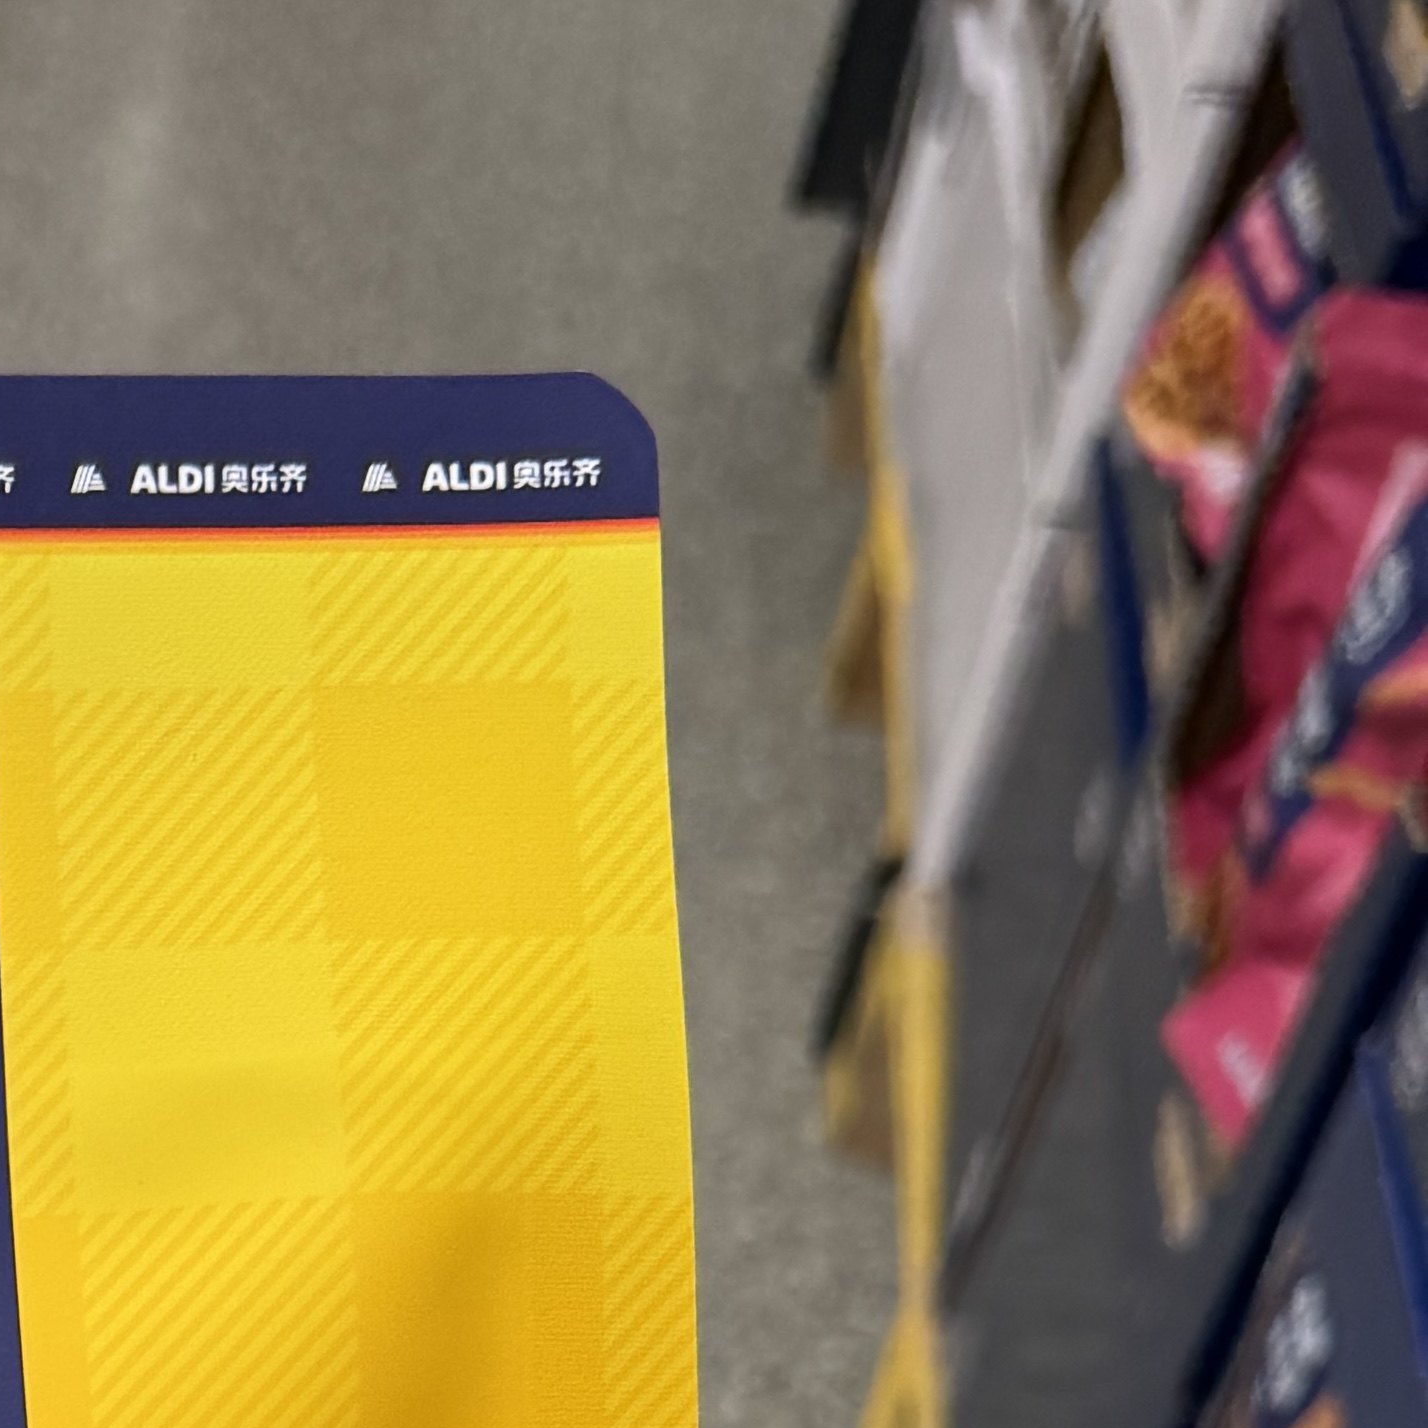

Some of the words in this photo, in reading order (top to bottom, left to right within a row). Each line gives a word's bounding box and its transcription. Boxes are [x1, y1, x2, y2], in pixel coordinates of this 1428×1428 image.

[130, 463, 215, 494] ALDI
[221, 463, 307, 494] 奥乐齐
[422, 461, 507, 492] ALDI
[513, 458, 601, 489] 奥乐齐
